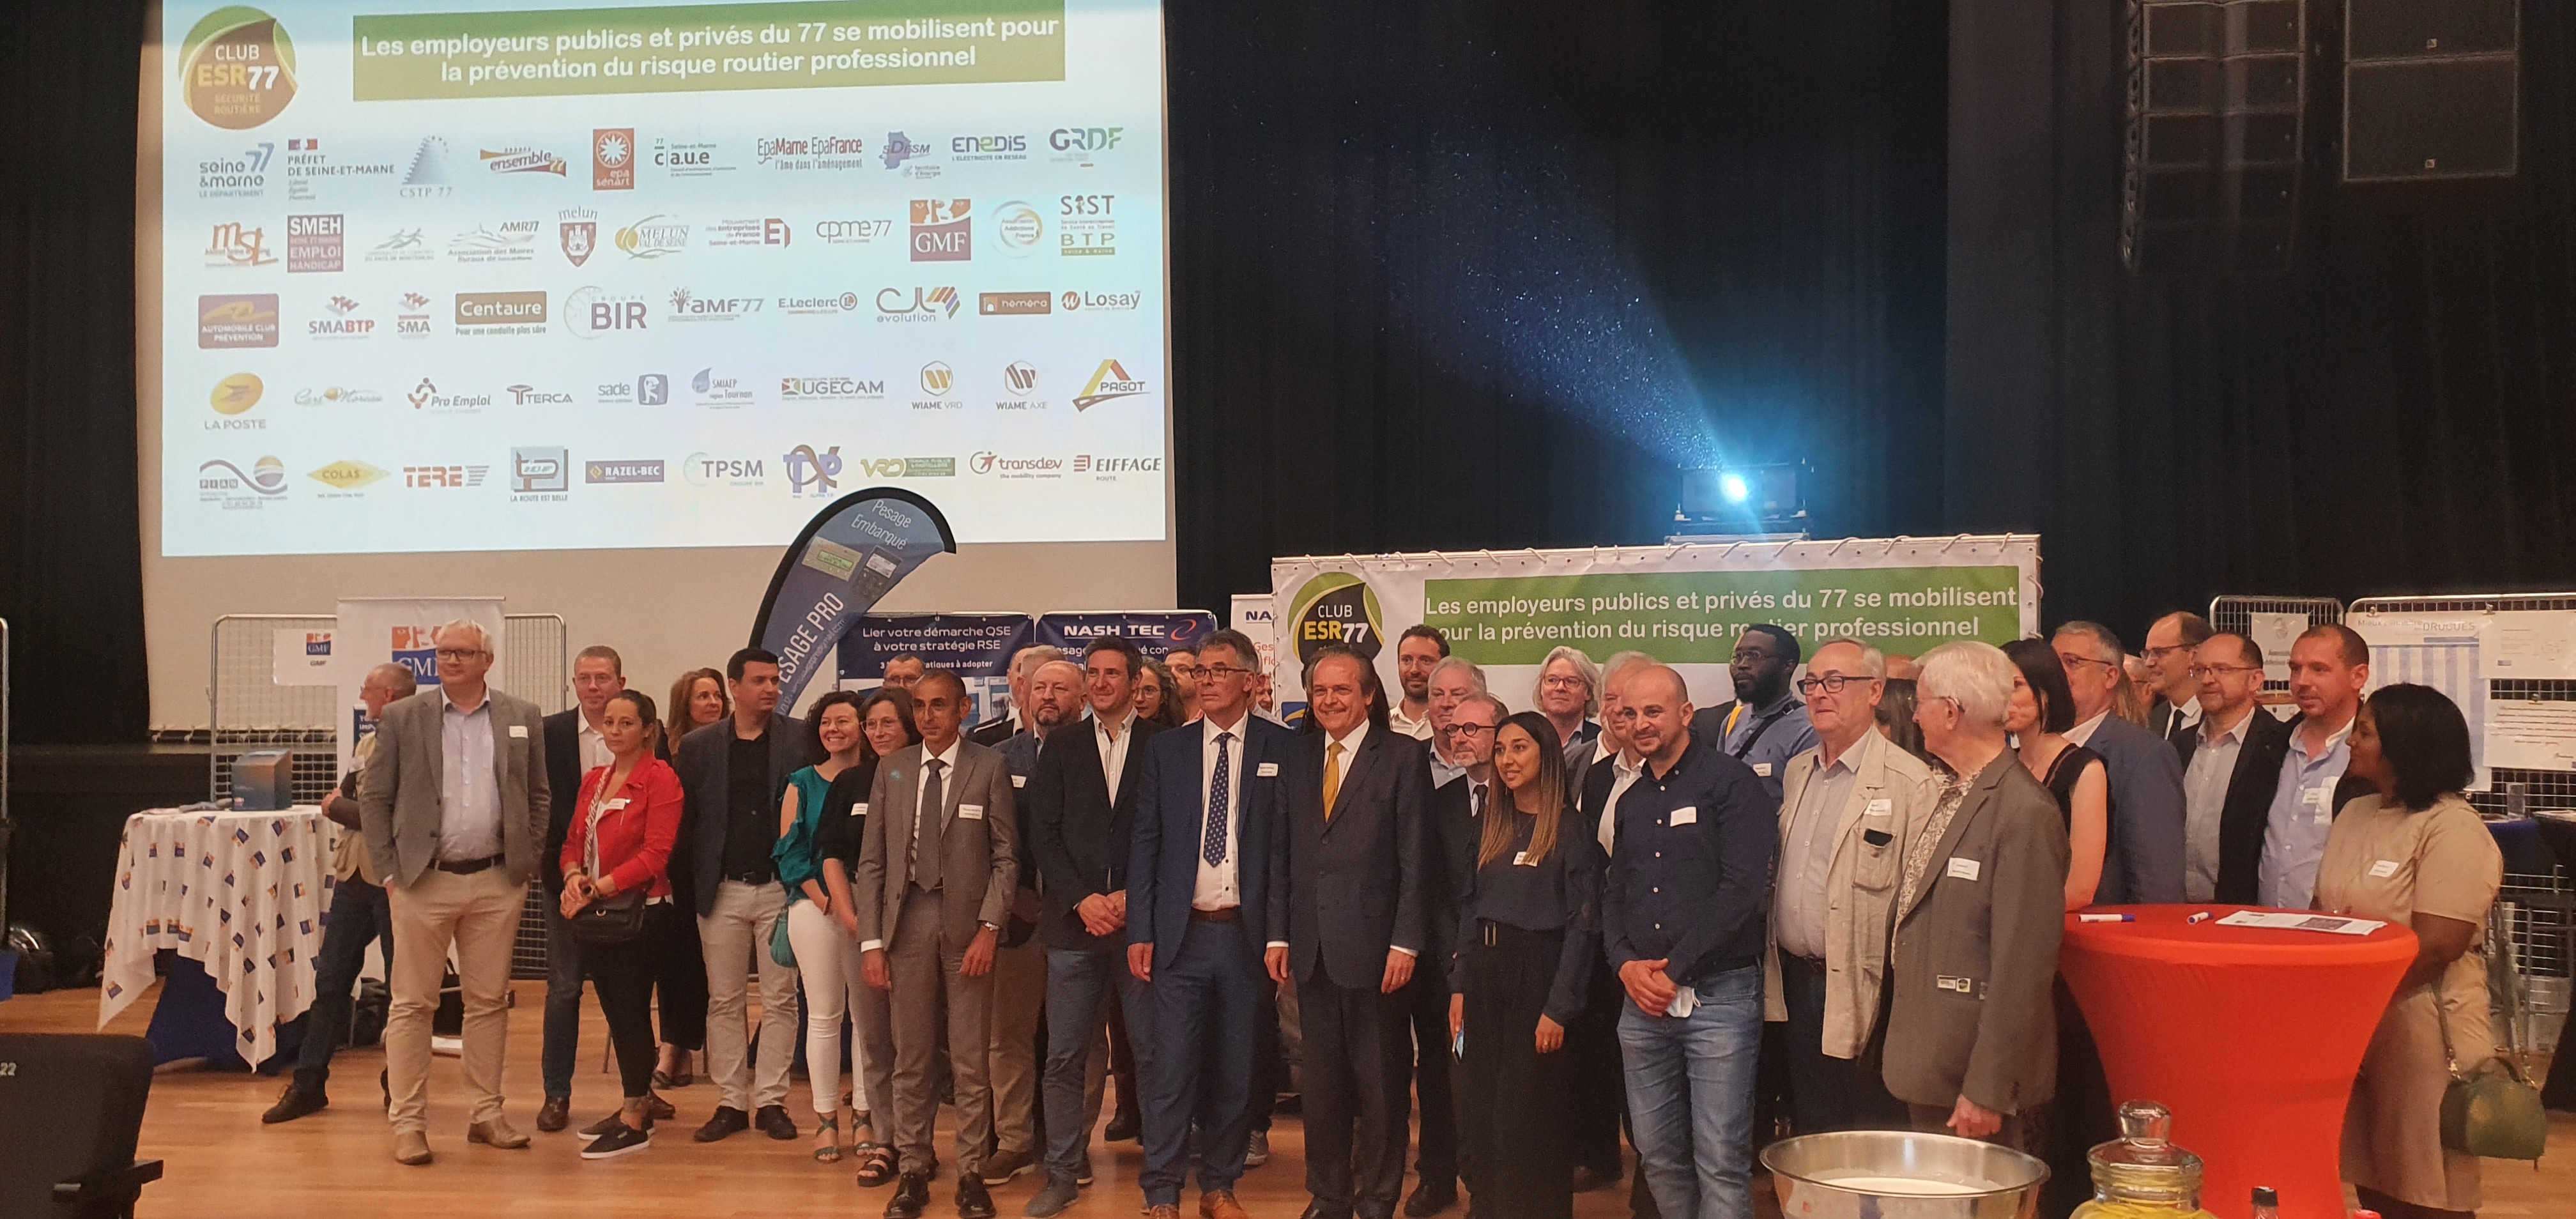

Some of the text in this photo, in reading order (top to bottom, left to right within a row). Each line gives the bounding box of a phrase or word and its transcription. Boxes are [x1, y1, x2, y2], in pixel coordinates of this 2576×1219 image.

[362, 18, 1059, 59] Les employeurs publics et privés du 77 se mobilisent pour
[215, 44, 260, 61] CLUB
[441, 45, 976, 85] la prévention du risque routier professionnel
[197, 65, 280, 91] ESR77
[1050, 127, 1124, 151] GRDF
[758, 136, 862, 158] EpaMarne EpaFrance
[199, 158, 245, 174] seine
[288, 154, 326, 165] PRÉFET
[489, 150, 551, 171] ensemble
[288, 164, 395, 176] DE SEINE-ET-MARNE
[610, 169, 629, 181] epa
[400, 187, 452, 198] CSTP 77
[558, 206, 598, 221] melun
[290, 217, 341, 236] SMEH
[640, 229, 689, 239] MELUN
[915, 232, 967, 253] GMF
[290, 245, 341, 259] EMPLOI
[289, 259, 341, 270] HANDICAP
[778, 296, 838, 308] E.Leclerc
[1085, 291, 1141, 310] Losay
[460, 300, 542, 318] Centaure
[591, 302, 647, 330] BIR
[877, 313, 936, 323] evolution
[309, 319, 375, 334] SMABTP
[397, 321, 431, 334] SMA
[456, 326, 471, 336] Pour
[599, 381, 630, 396] sade
[802, 381, 884, 395] UGECAM
[1100, 381, 1146, 392] PAGOT
[431, 395, 491, 408] Pro Emploi
[526, 393, 573, 404] TERCA
[912, 401, 963, 410] WIAME VRD
[996, 401, 1047, 410] WIAME AXE
[204, 418, 266, 430] LA POSTE
[702, 460, 763, 478] TPSM
[999, 457, 1062, 470] transdev
[1096, 458, 1162, 471] EIFFAGE
[322, 469, 360, 479] COLAS
[403, 466, 462, 487] TERE
[606, 465, 659, 477] RAZEL-BEC
[872, 499, 912, 528] Pesage
[852, 514, 907, 551] Embarqué
[1425, 586, 2019, 617] Les employeurs publics et privés du 77 se mobilisent
[1246, 611, 1272, 620] NA
[1318, 605, 1353, 618] CLUB
[862, 626, 1011, 638] Lier votre démarche QSE
[1064, 625, 1165, 636] NASH TEC
[1304, 620, 1368, 643] ESR77
[1439, 626, 1473, 641] our
[1479, 623, 1496, 641] la
[1501, 620, 1612, 643] prévention
[1618, 619, 1645, 638] du
[1652, 620, 1723, 642] risque
[1814, 617, 1979, 641] professionnel
[308, 643, 328, 654] GMF
[778, 624, 818, 695] ESAGE
[806, 592, 844, 631] PRO
[873, 640, 1000, 652] à votre stratégie RSE
[925, 661, 954, 669] atiques
[956, 659, 961, 668] à
[962, 660, 993, 670] adopter
